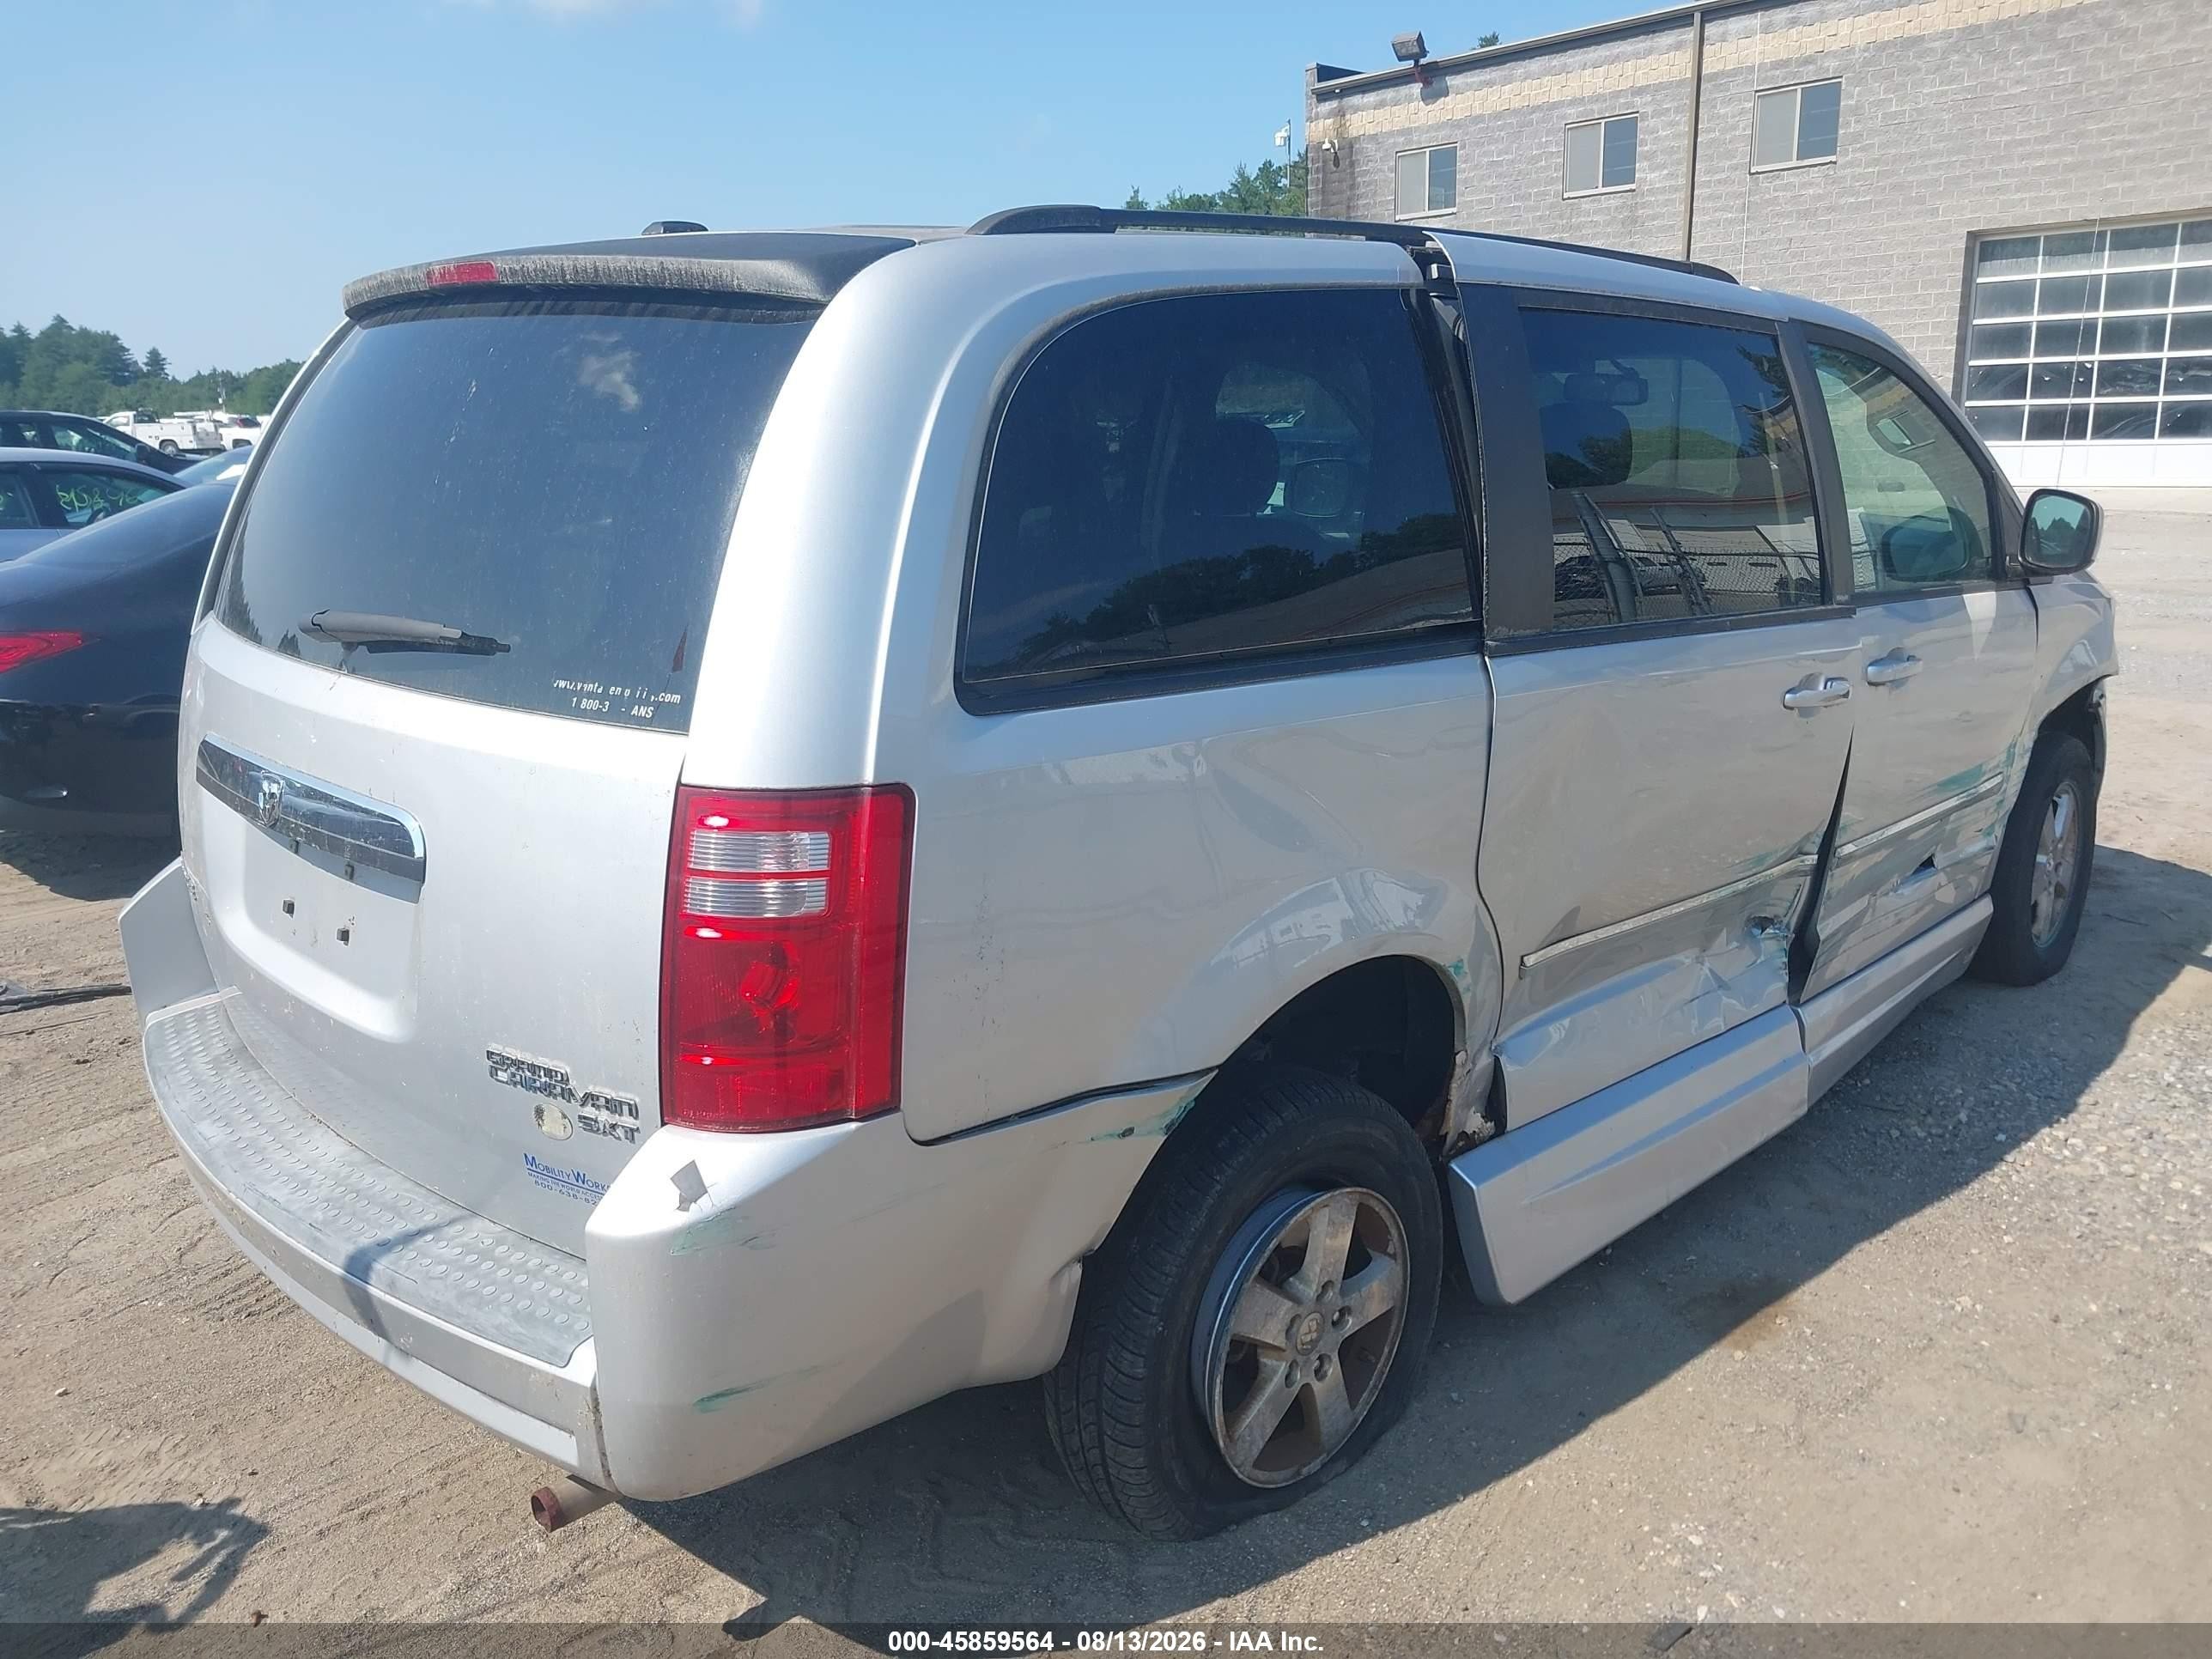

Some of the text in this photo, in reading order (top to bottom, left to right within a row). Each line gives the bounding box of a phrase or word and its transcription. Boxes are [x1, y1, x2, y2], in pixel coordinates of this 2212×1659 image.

[485, 1048, 571, 1085] GRAND
[488, 1064, 640, 1121] CARAVAN
[577, 1113, 641, 1145] SXT
